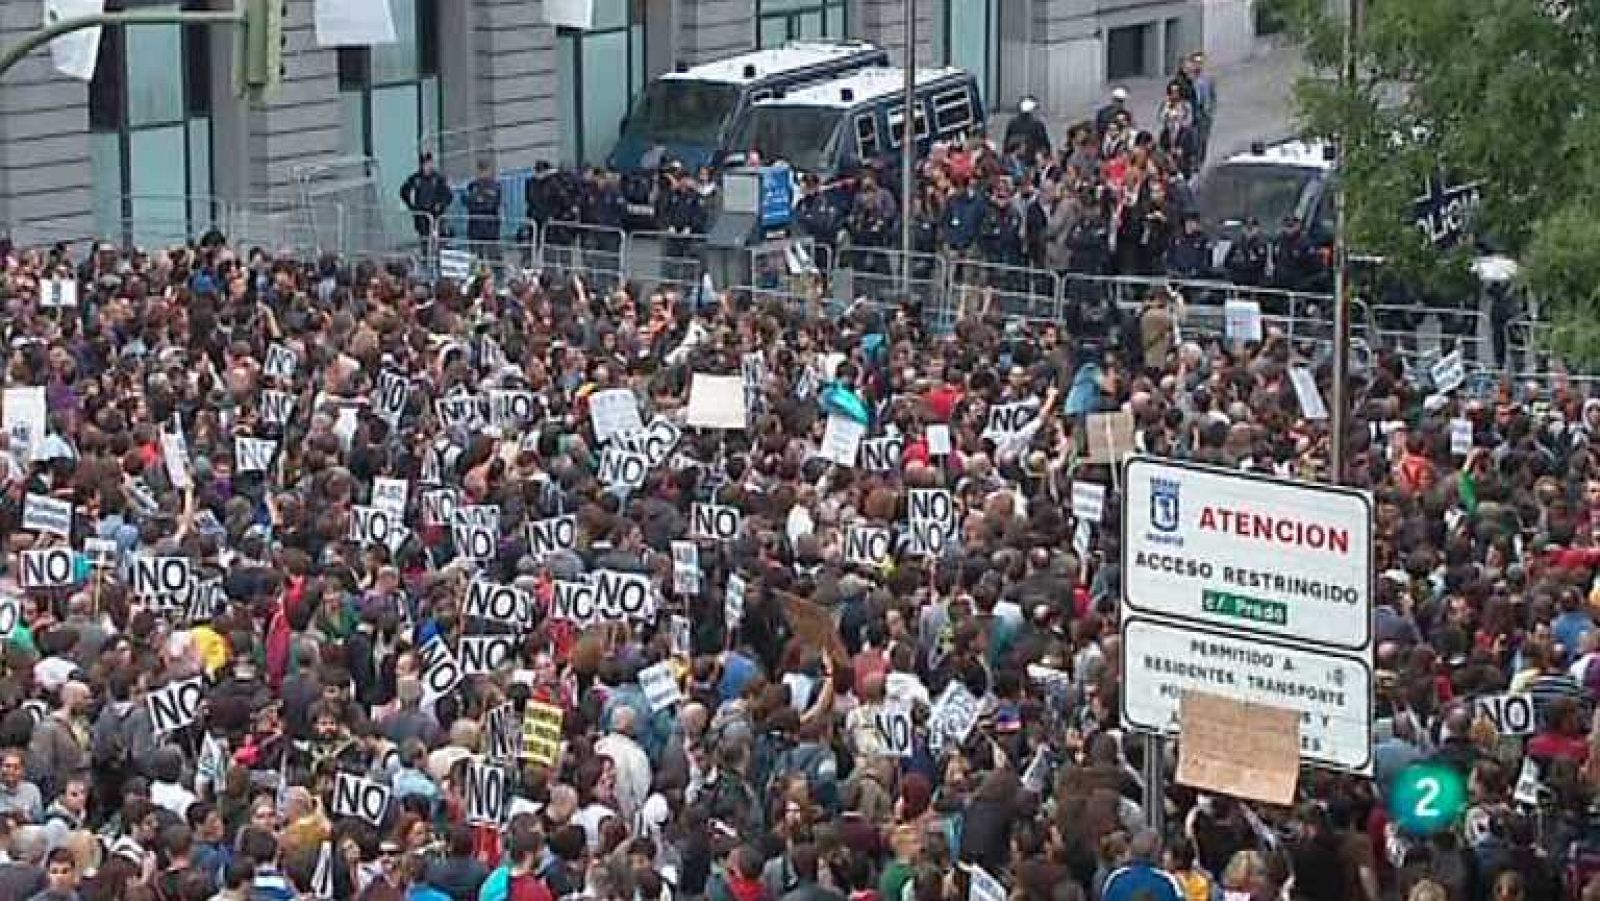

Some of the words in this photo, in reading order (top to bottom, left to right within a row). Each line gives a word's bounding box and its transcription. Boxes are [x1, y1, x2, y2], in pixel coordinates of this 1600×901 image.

[992, 405, 1036, 431] NO
[602, 451, 644, 484] NO
[696, 506, 738, 538] NO
[912, 491, 949, 521] NO
[353, 510, 388, 541] NO
[531, 518, 574, 550] NO
[914, 522, 943, 553] NO
[1199, 506, 1349, 553] ATENCION
[456, 528, 492, 558] NO
[849, 529, 889, 562] NO
[24, 550, 71, 584] NO
[139, 559, 186, 592] NO
[1135, 551, 1213, 578] ACCESO
[1224, 566, 1358, 605] RESTRINGIDO
[467, 583, 517, 619] NO
[597, 573, 645, 613] NO
[461, 639, 509, 671] NO
[1191, 639, 1274, 668] PERMITIDO
[1144, 655, 1234, 684] RESIDENTES
[1248, 675, 1345, 705] TRANSPORTE
[152, 682, 201, 730] NO
[875, 713, 909, 752] NO
[337, 775, 387, 823] NO
[470, 767, 501, 821] NO
